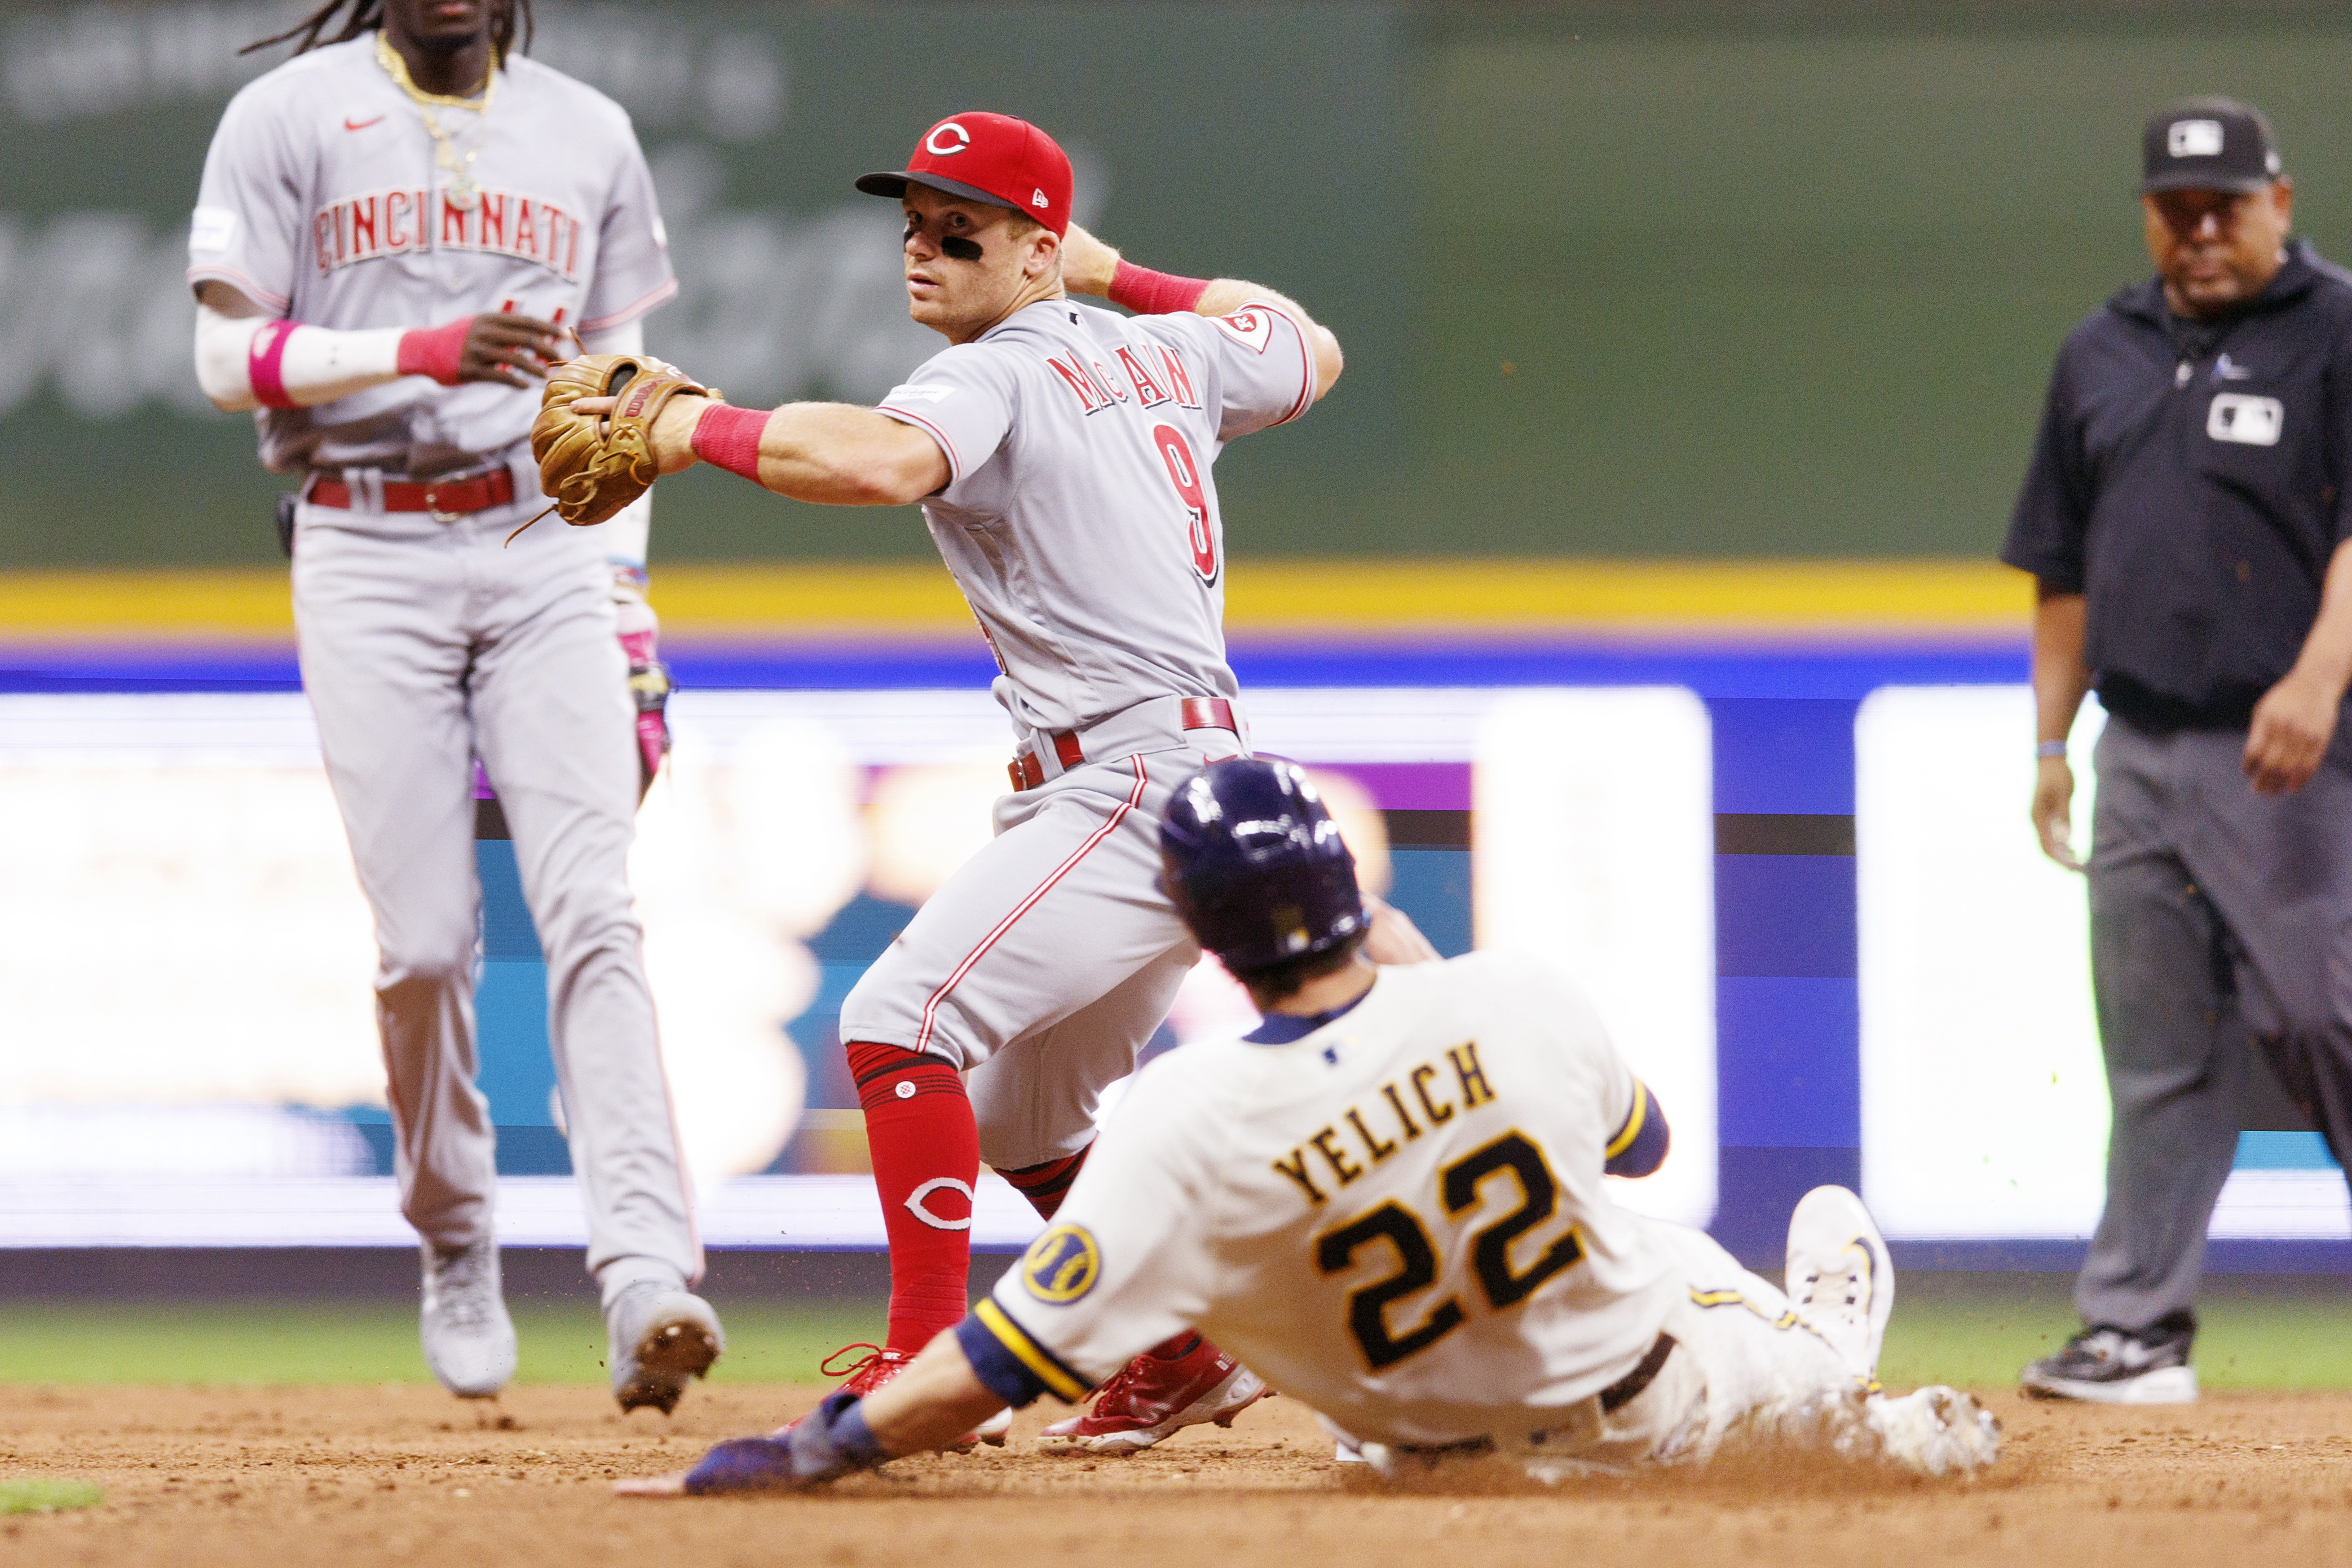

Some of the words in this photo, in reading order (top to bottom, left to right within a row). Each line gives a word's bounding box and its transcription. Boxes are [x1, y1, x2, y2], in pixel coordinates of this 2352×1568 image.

[314, 187, 580, 276] CINCINNATI
[1152, 421, 1219, 589] 9
[1272, 1041, 1497, 1207] YELICH
[1310, 1127, 1587, 1379] 22
